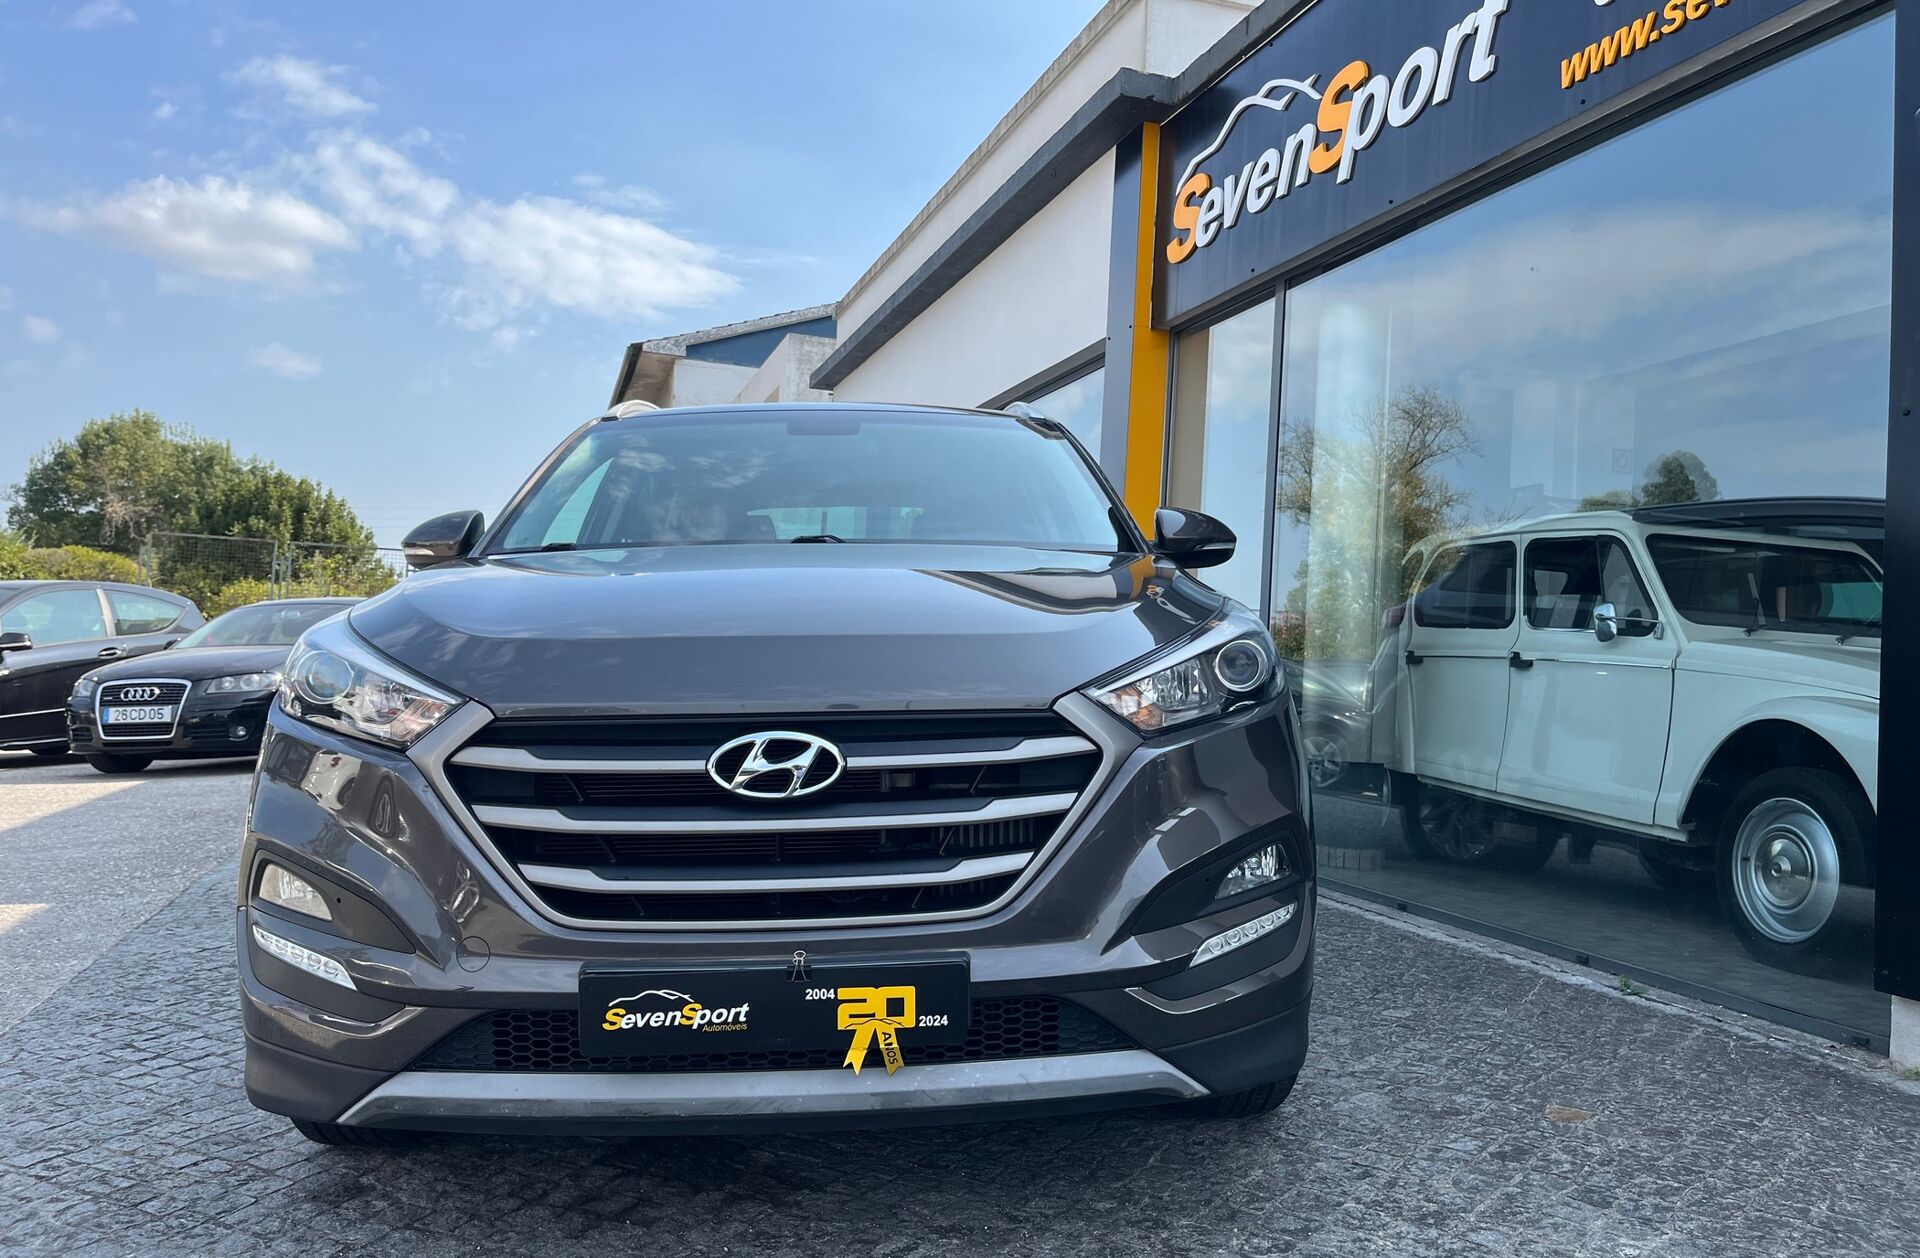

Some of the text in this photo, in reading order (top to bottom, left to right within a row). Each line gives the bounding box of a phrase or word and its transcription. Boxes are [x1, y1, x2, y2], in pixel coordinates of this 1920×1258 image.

[1561, 0, 1731, 89] www.se
[1167, 0, 1507, 263] SevenSport
[805, 988, 835, 1000] 2004
[837, 985, 916, 1030] 20
[602, 1002, 749, 1031] SevenSport
[702, 1023, 748, 1033] Automóveis
[918, 1014, 948, 1027] 2024
[882, 1031, 899, 1065] ANOS
